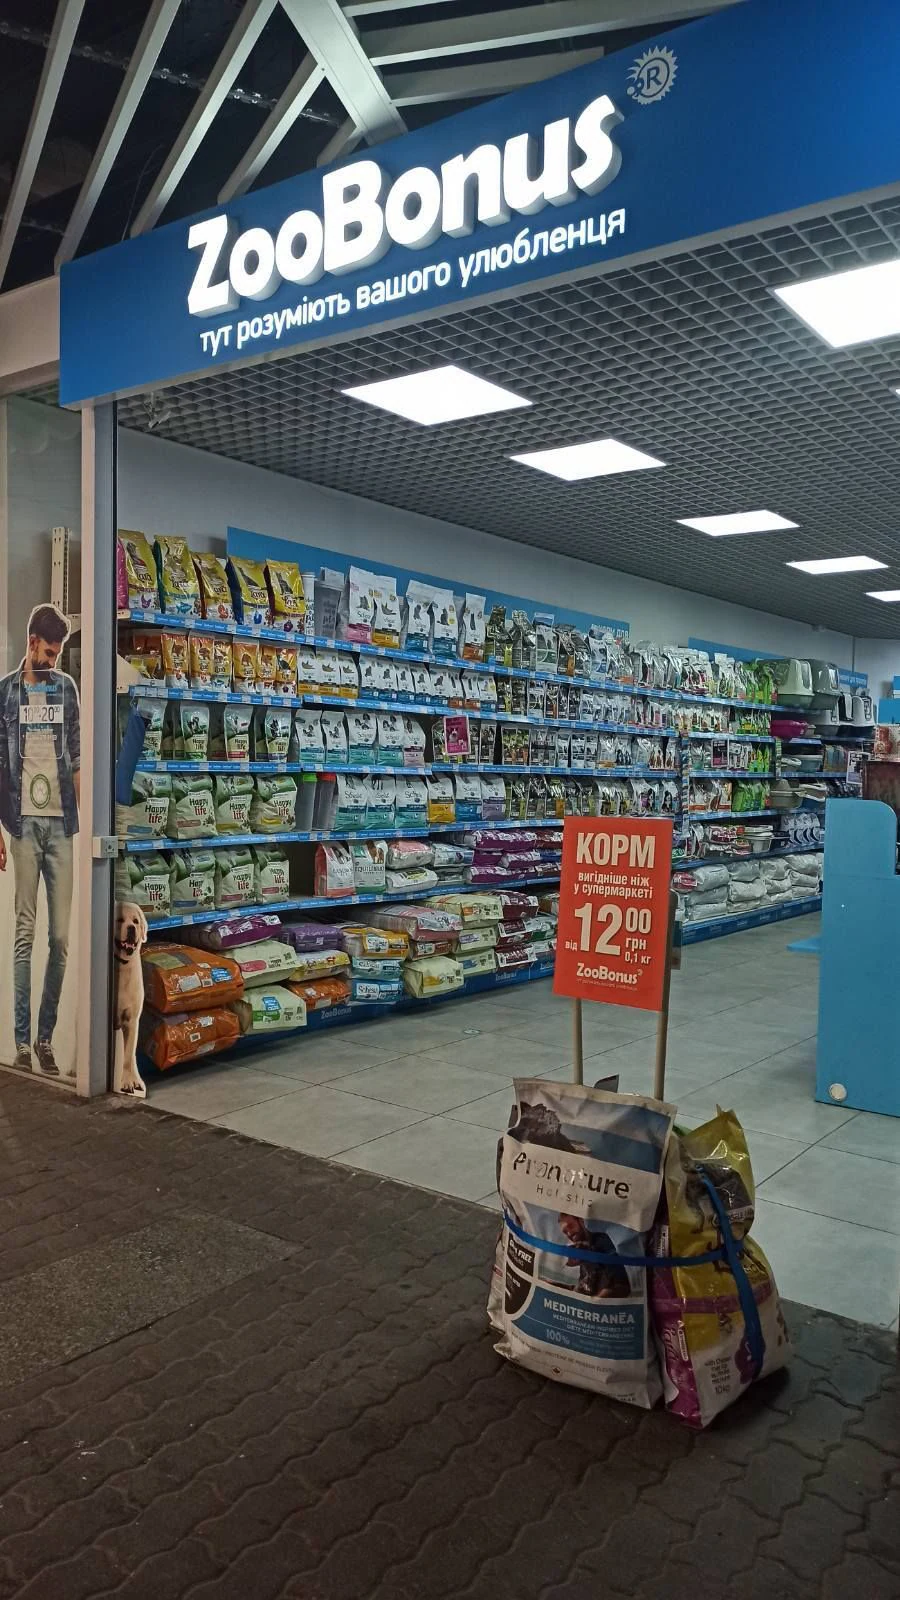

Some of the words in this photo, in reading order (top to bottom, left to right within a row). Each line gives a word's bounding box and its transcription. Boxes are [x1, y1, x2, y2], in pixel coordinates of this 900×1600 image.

[187, 94, 624, 317] ZooBonus
[200, 325, 233, 356] тут
[237, 292, 351, 349] розуміють
[356, 262, 451, 310] вашого
[458, 208, 626, 288] улюбленця
[41, 706, 54, 722] 20
[145, 805, 167, 814] Happy
[190, 798, 208, 808] Happy
[194, 806, 207, 816] life
[148, 813, 163, 824] life
[576, 832, 656, 869] КОРМ
[578, 871, 628, 886] вигідніше
[630, 874, 650, 887] ніж
[144, 883, 166, 892] Happy
[573, 882, 579, 895] у
[582, 884, 653, 900] супермаркеті
[149, 891, 164, 901] life
[565, 940, 578, 951] від
[574, 902, 623, 956] 12
[625, 907, 652, 934] 00
[625, 937, 647, 952] грн
[624, 951, 638, 964] 0,1
[640, 955, 652, 965] кг
[576, 962, 638, 985] ZooBonus
[536, 1184, 593, 1207] Holstic
[518, 1250, 532, 1263] FREE
[545, 1329, 570, 1345] 100%
